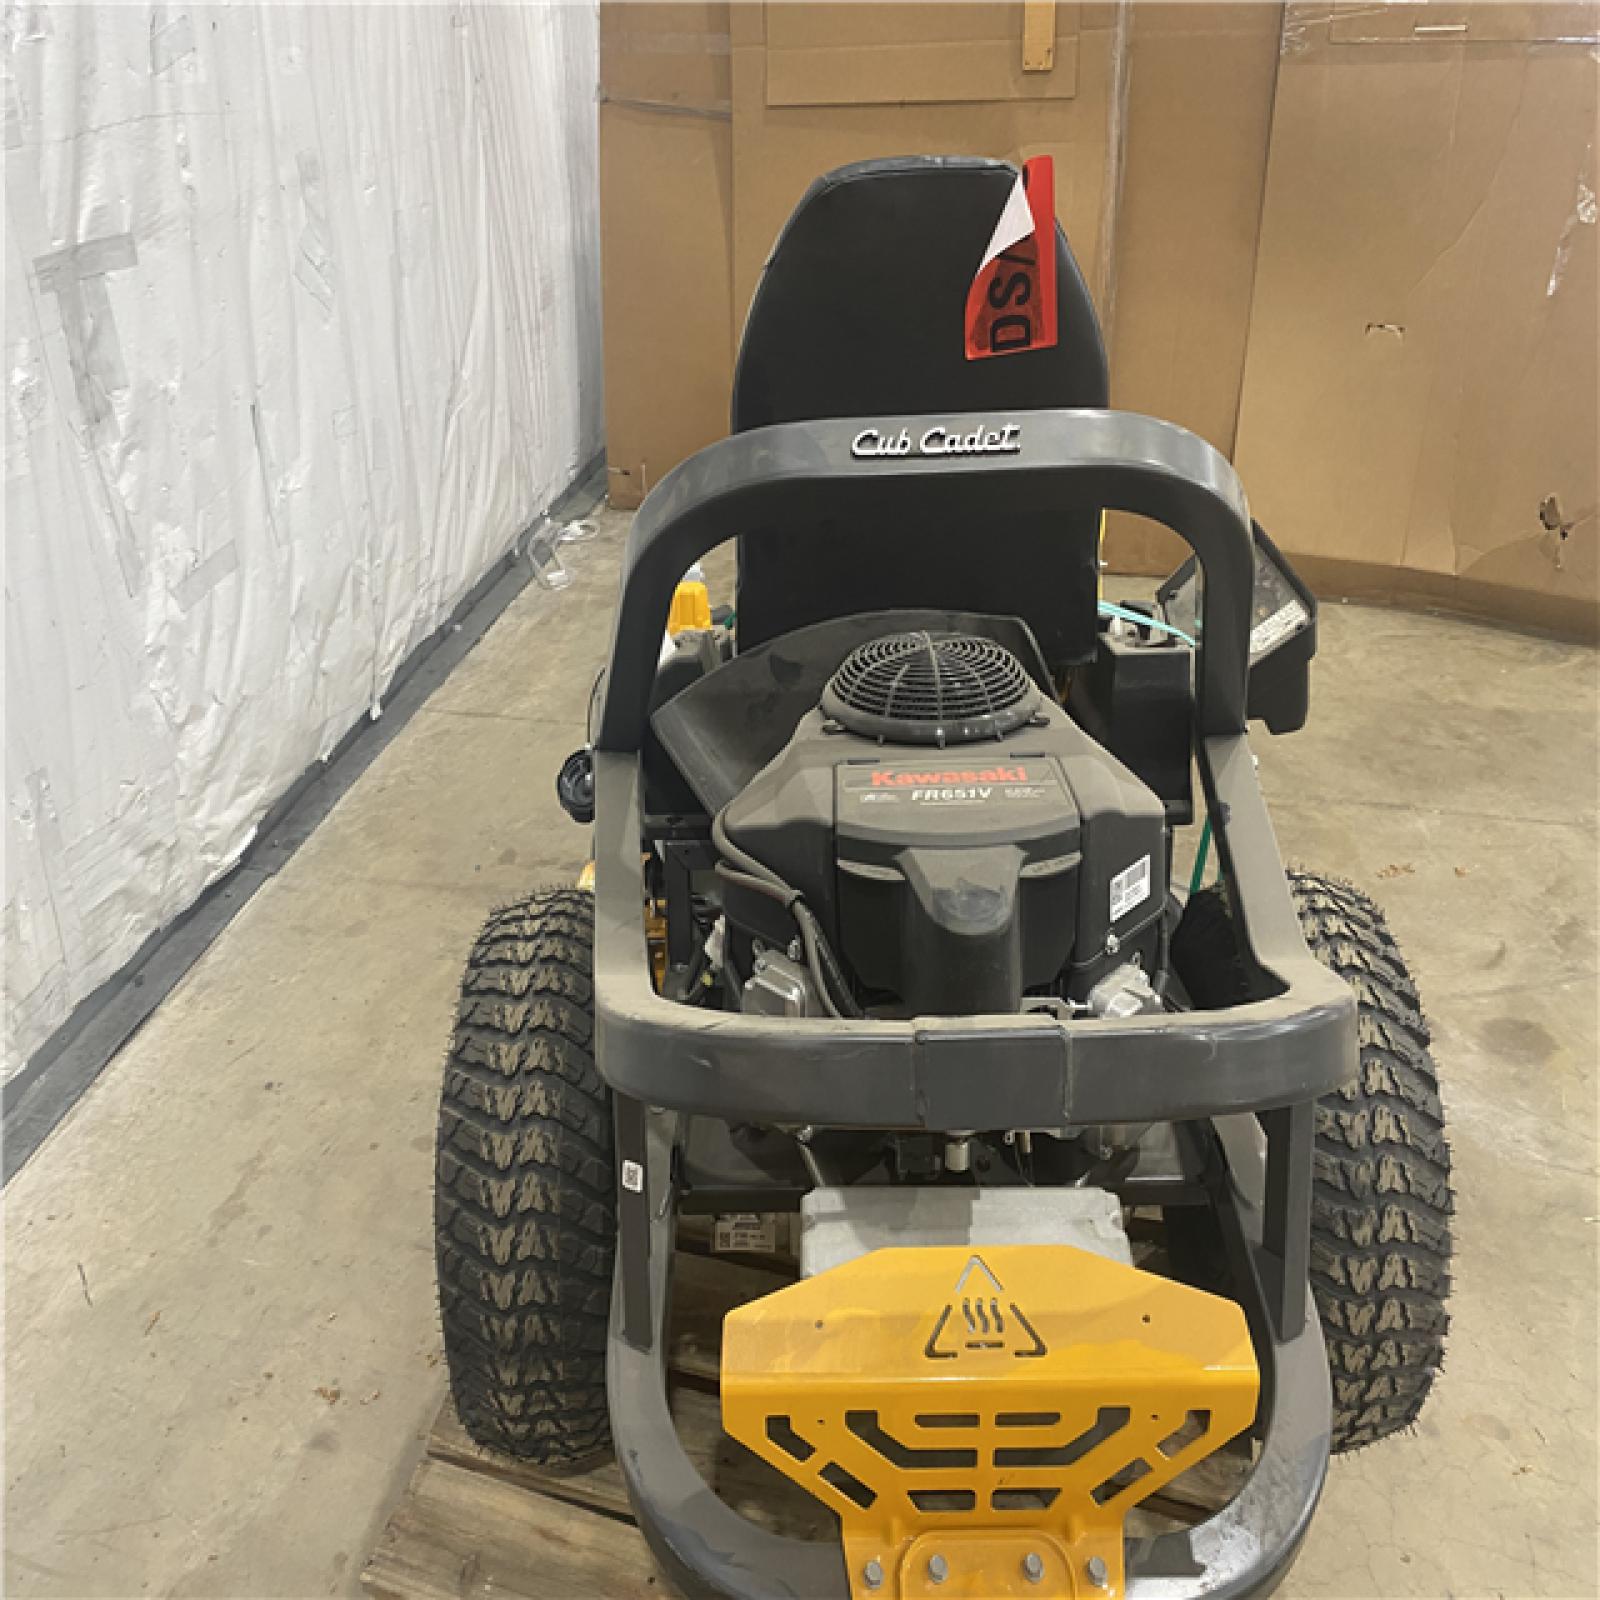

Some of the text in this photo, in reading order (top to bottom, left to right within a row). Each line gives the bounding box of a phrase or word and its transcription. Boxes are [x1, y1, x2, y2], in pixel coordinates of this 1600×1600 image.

[851, 422, 1021, 456] Cub Cadet
[871, 766, 1027, 786] Kawasaki
[911, 787, 993, 802] FR651V
